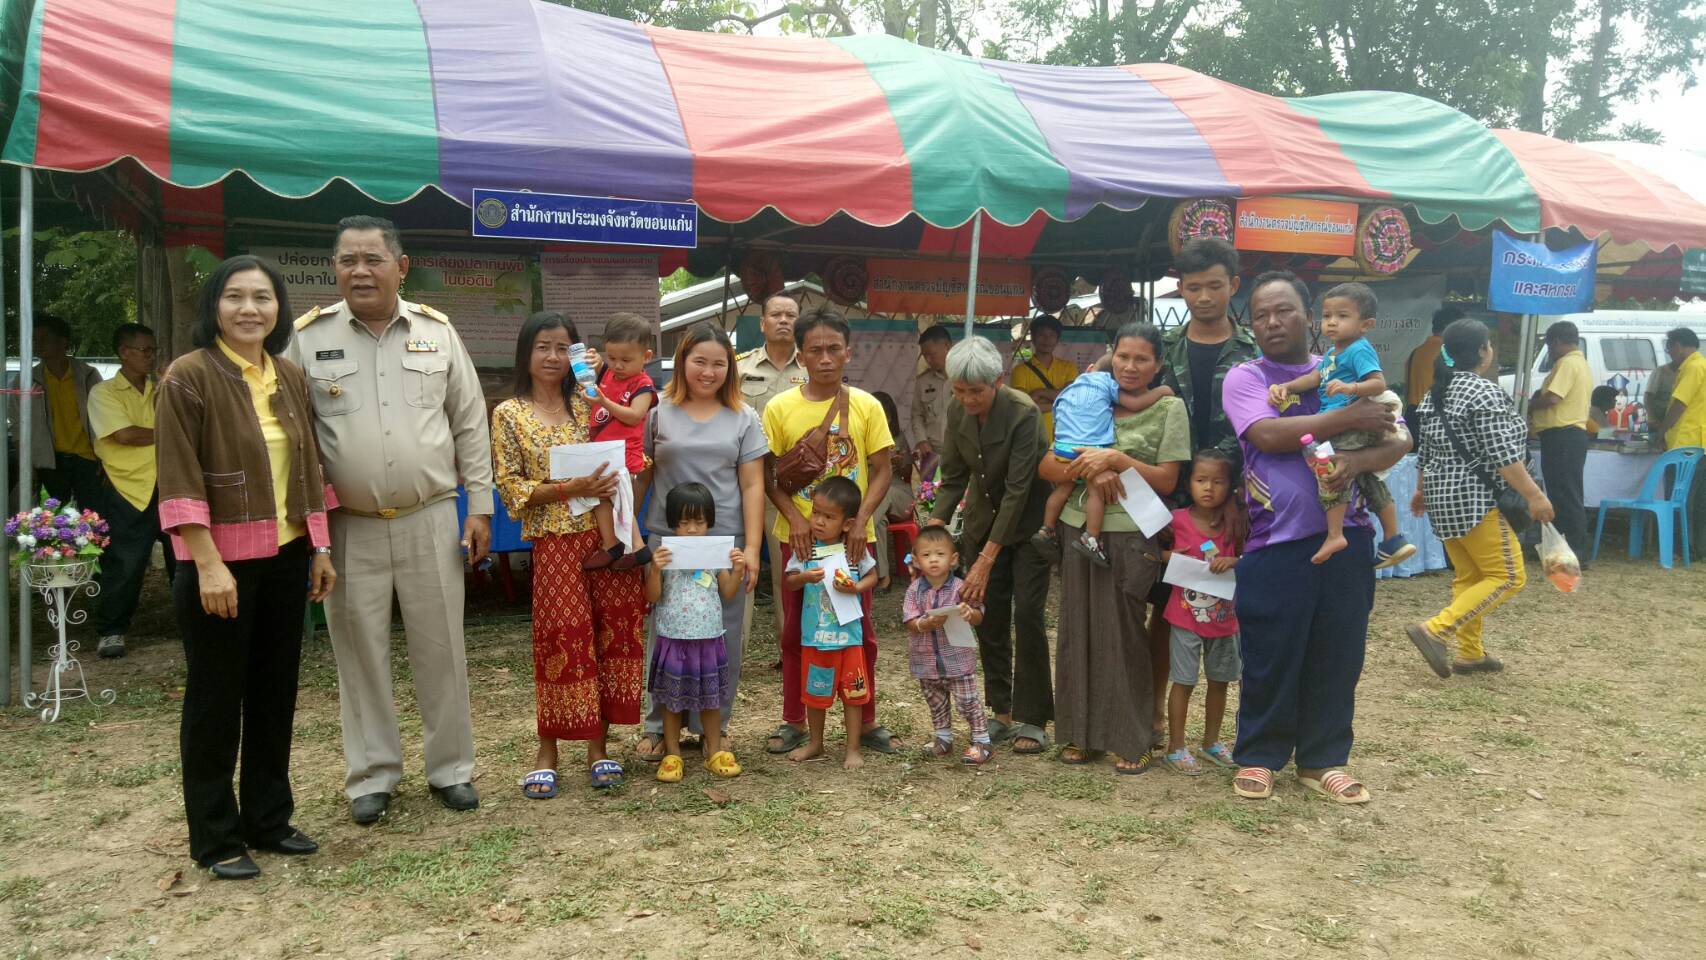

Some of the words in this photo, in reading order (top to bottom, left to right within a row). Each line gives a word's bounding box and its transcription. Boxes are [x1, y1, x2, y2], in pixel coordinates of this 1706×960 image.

[510, 203, 694, 232] สำนักงานประมงจังหวัดขอนแก่น
[873, 273, 1025, 297] สำนักงานตรวจบัญชีสหรณ์ขอนแก่น
[595, 763, 622, 773] FILA
[525, 773, 554, 783] FILA
